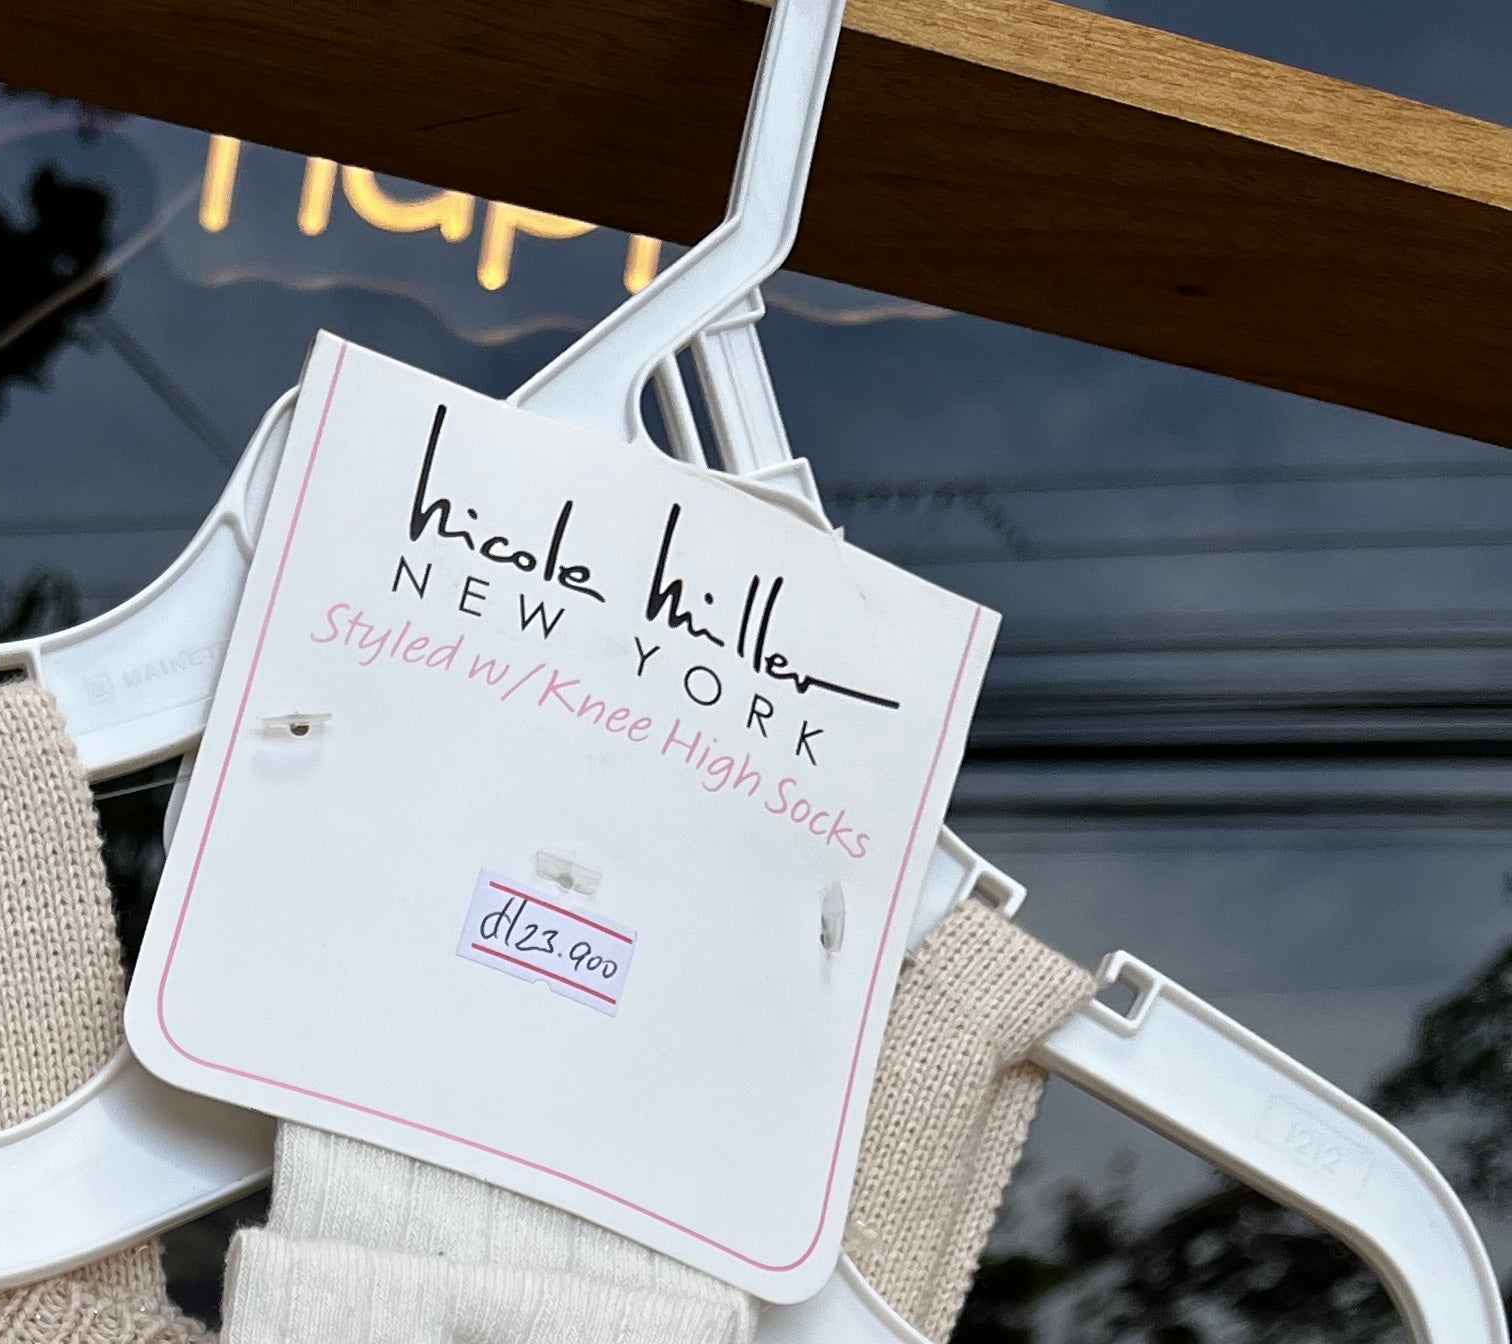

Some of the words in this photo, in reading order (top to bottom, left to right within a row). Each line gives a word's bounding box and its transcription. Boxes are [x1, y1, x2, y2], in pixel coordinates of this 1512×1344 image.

[310, 602, 465, 668] Styled
[661, 718, 762, 797] High
[764, 777, 871, 861] Socks
[391, 555, 566, 640] NEW
[634, 635, 825, 768] YORK
